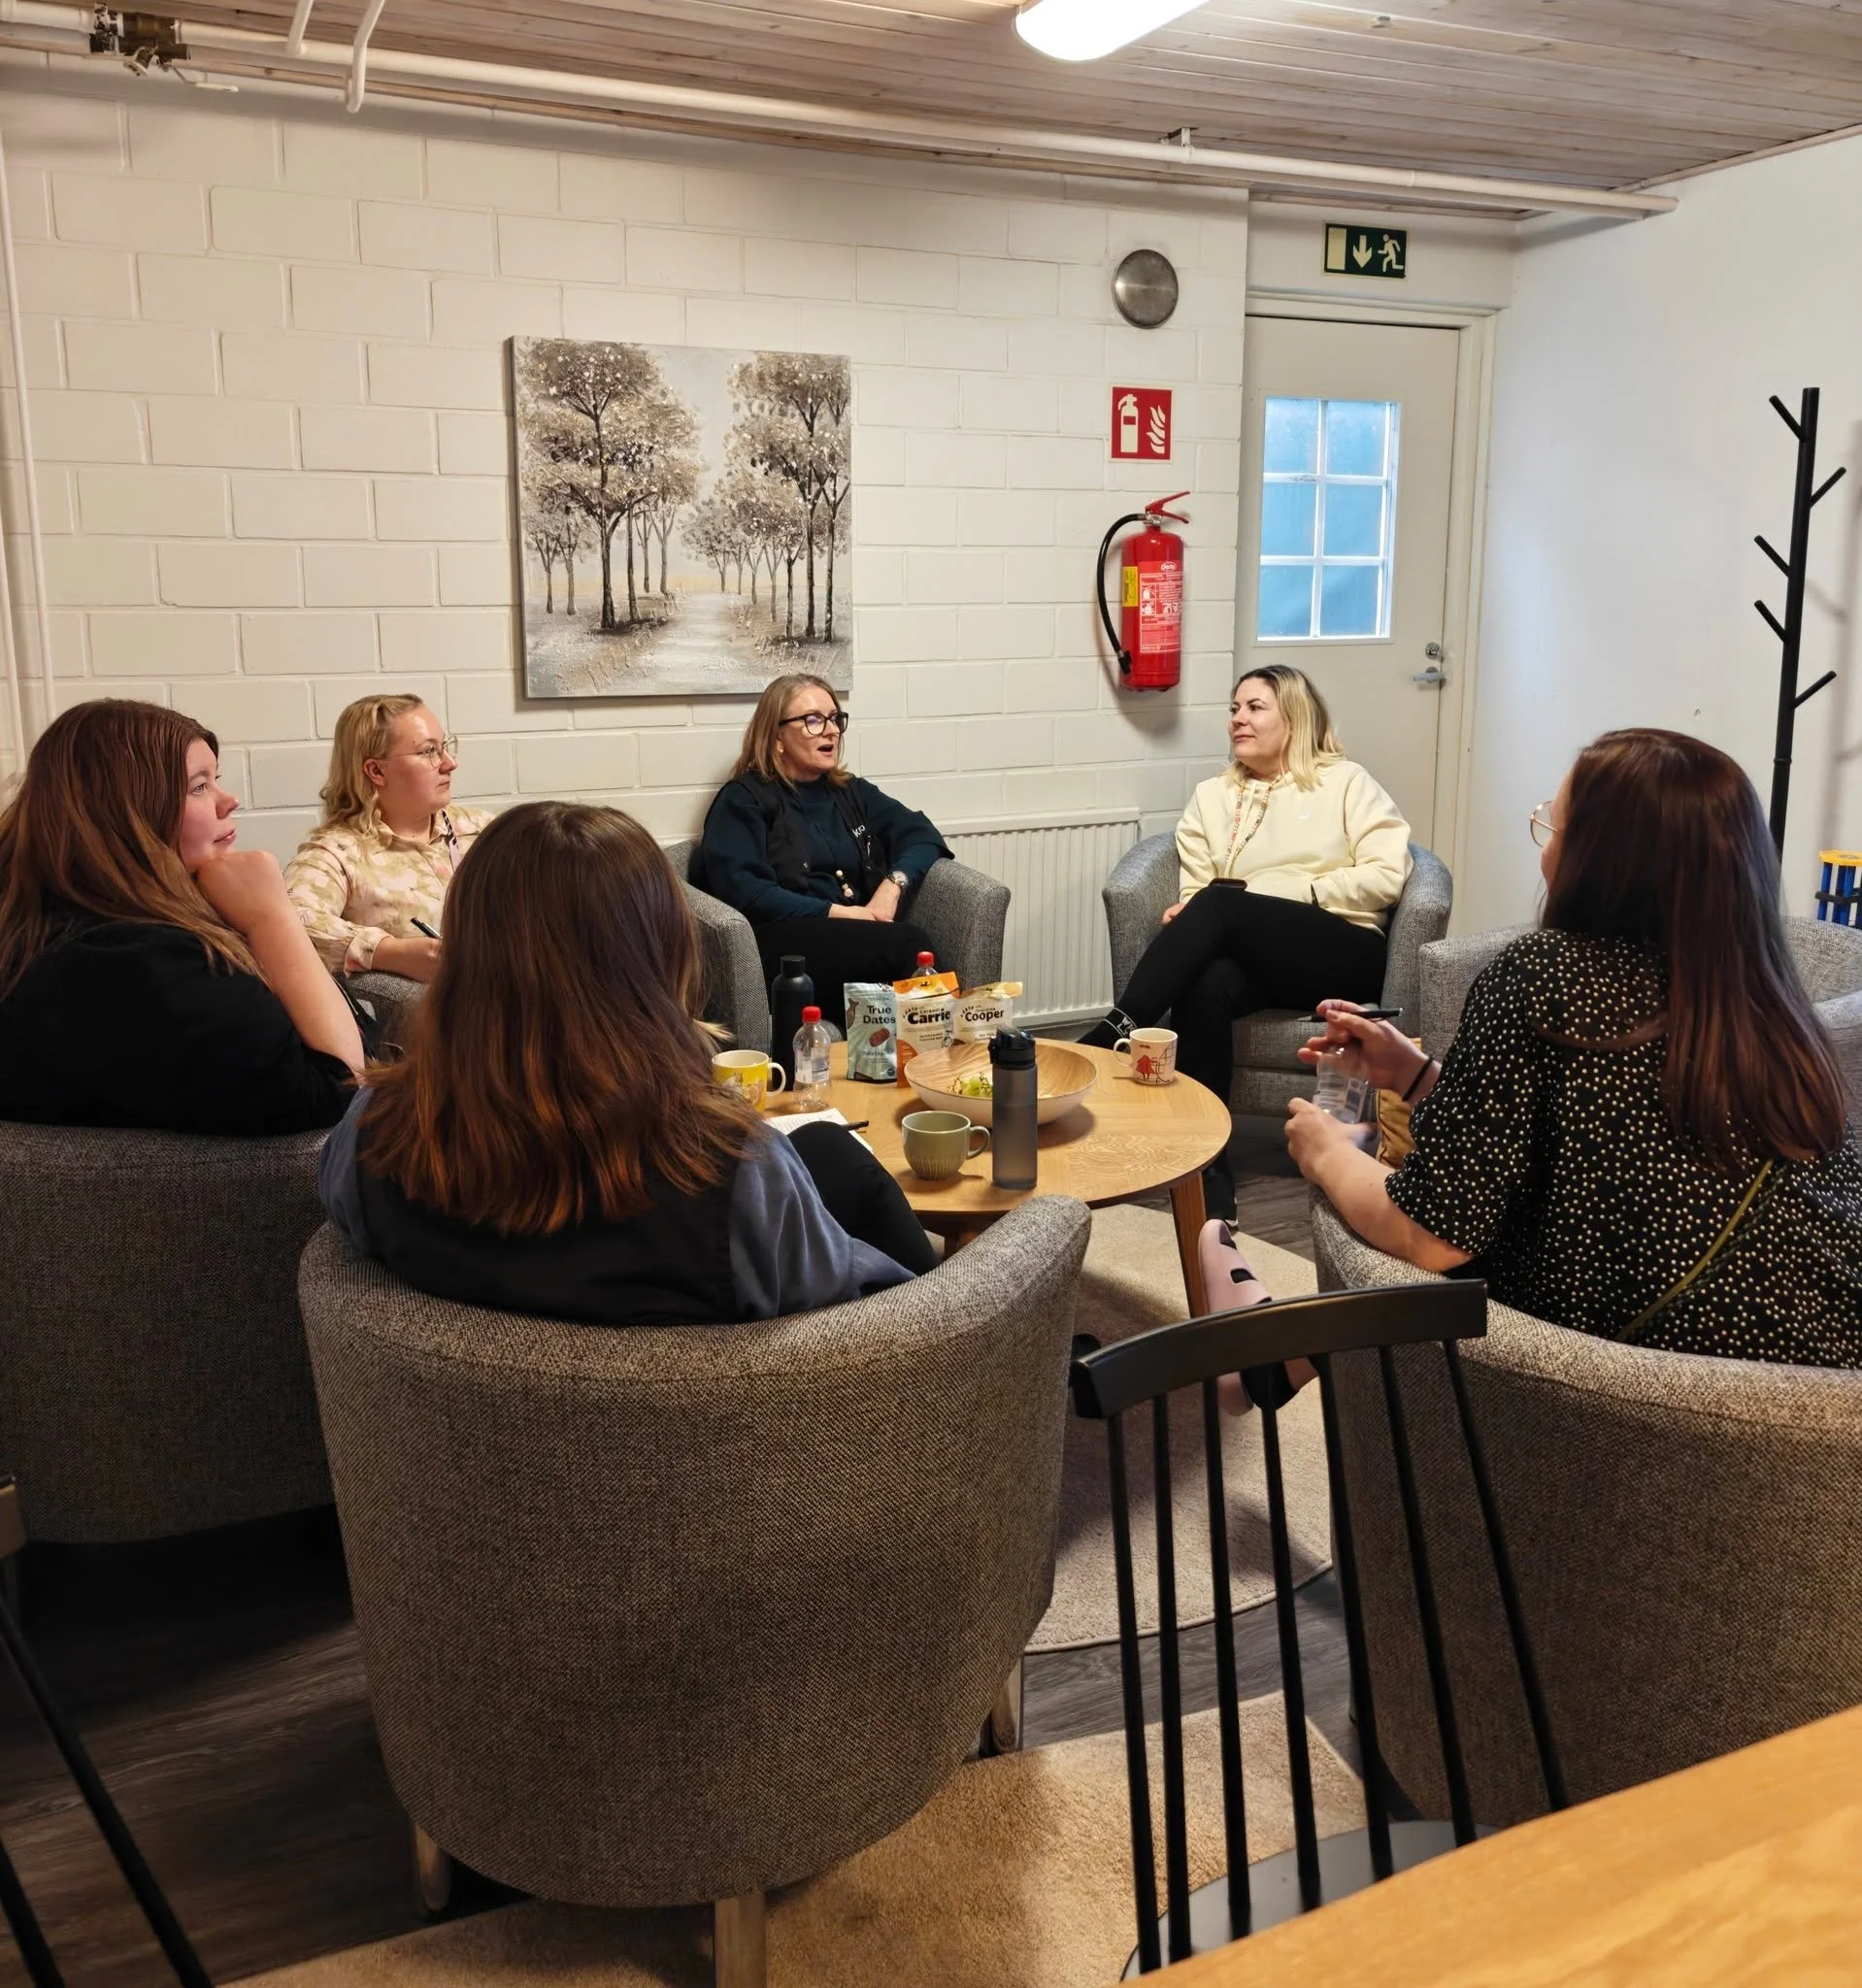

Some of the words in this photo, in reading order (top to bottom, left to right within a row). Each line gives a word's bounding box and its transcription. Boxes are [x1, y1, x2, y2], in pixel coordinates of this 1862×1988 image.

[867, 1005, 892, 1014] True
[862, 1014, 896, 1024] Dates
[908, 1009, 950, 1024] Carrie
[965, 1010, 1005, 1022] Cooper
